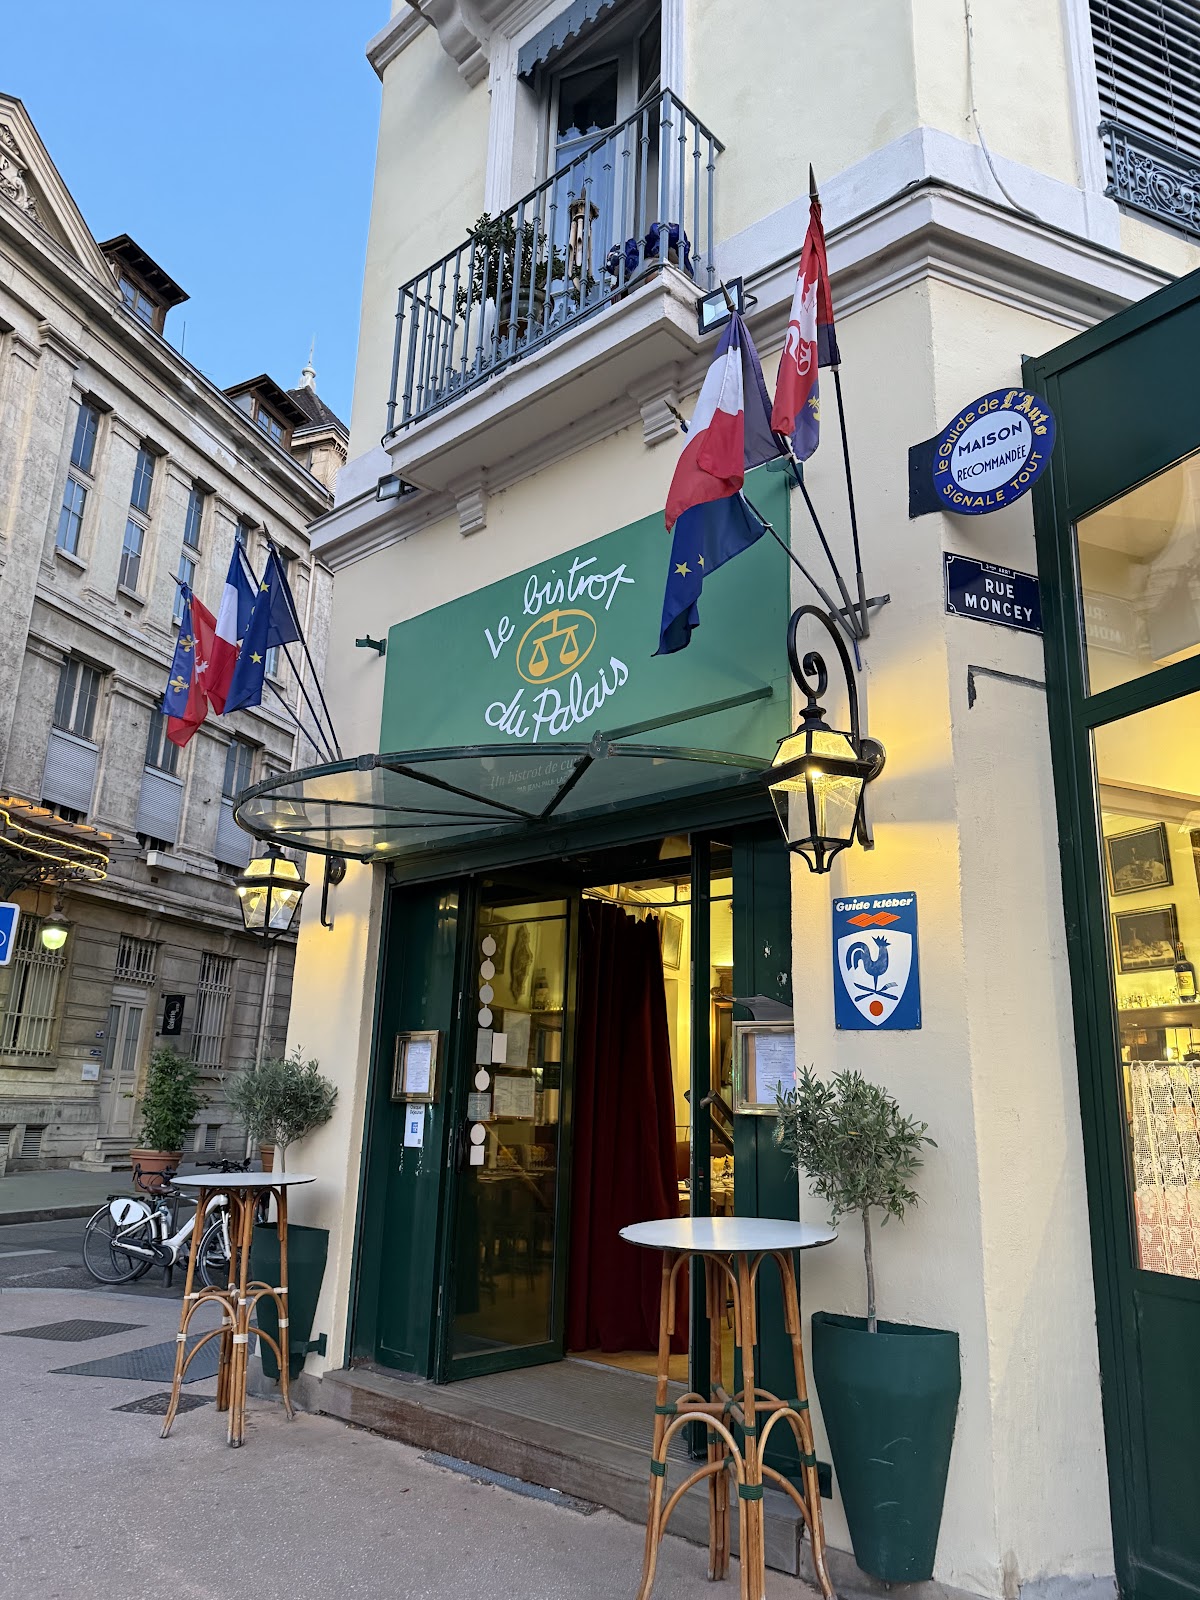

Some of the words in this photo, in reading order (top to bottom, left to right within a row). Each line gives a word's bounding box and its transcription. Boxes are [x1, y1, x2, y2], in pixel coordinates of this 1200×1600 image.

[978, 398, 1000, 415] de
[1000, 390, 1049, 436] L'Auto
[938, 412, 975, 457] Guide
[958, 420, 1023, 457] MAISON
[935, 459, 949, 476] le
[943, 484, 1005, 507] SIGNALE
[1010, 451, 1043, 490] TOUT
[957, 444, 1027, 482] RECOMMANDÉE
[522, 556, 635, 615] bistrot
[984, 578, 1015, 599] RUE
[964, 592, 1033, 622] MONCEY
[485, 688, 529, 738] du
[532, 656, 629, 744] Palais
[490, 775, 505, 789] Un
[507, 764, 543, 785] bistrot
[545, 760, 558, 776] de
[836, 898, 870, 912] Guide
